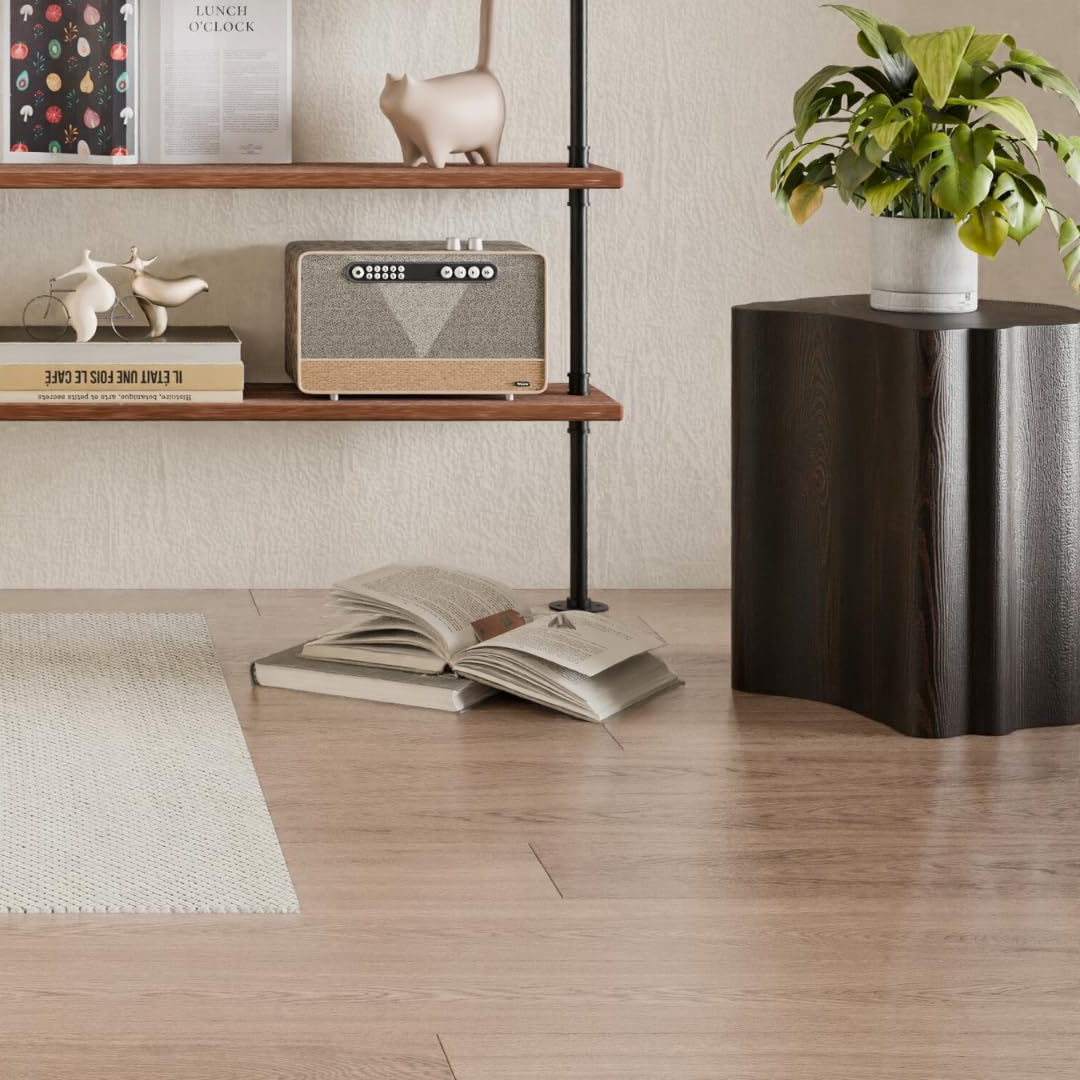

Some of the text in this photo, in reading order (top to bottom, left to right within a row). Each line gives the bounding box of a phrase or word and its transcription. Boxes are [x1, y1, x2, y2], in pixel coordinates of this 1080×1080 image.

[196, 5, 248, 17] LUNCH
[188, 20, 255, 33] O'CLOCK
[45, 370, 183, 387] IL ÉTAIT UNE FOIS LE CAFÉ
